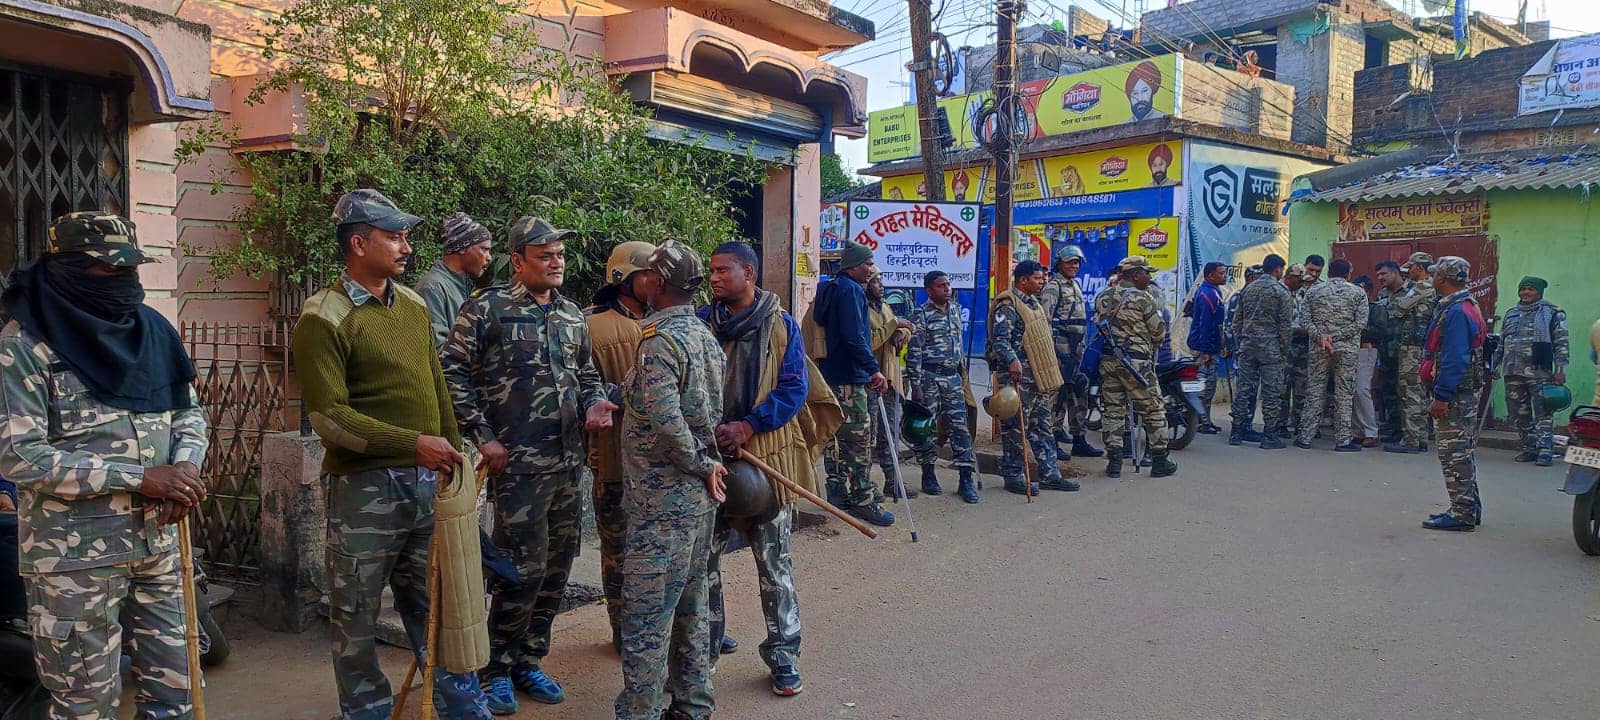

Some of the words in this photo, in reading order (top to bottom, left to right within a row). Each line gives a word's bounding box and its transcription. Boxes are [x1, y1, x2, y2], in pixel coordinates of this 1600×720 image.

[884, 122, 899, 133] BABU
[873, 133, 911, 147] ENTERPRISES
[1365, 206, 1404, 222] सत्यम्
[1407, 201, 1431, 216] वर्मा
[871, 210, 908, 238] राहत
